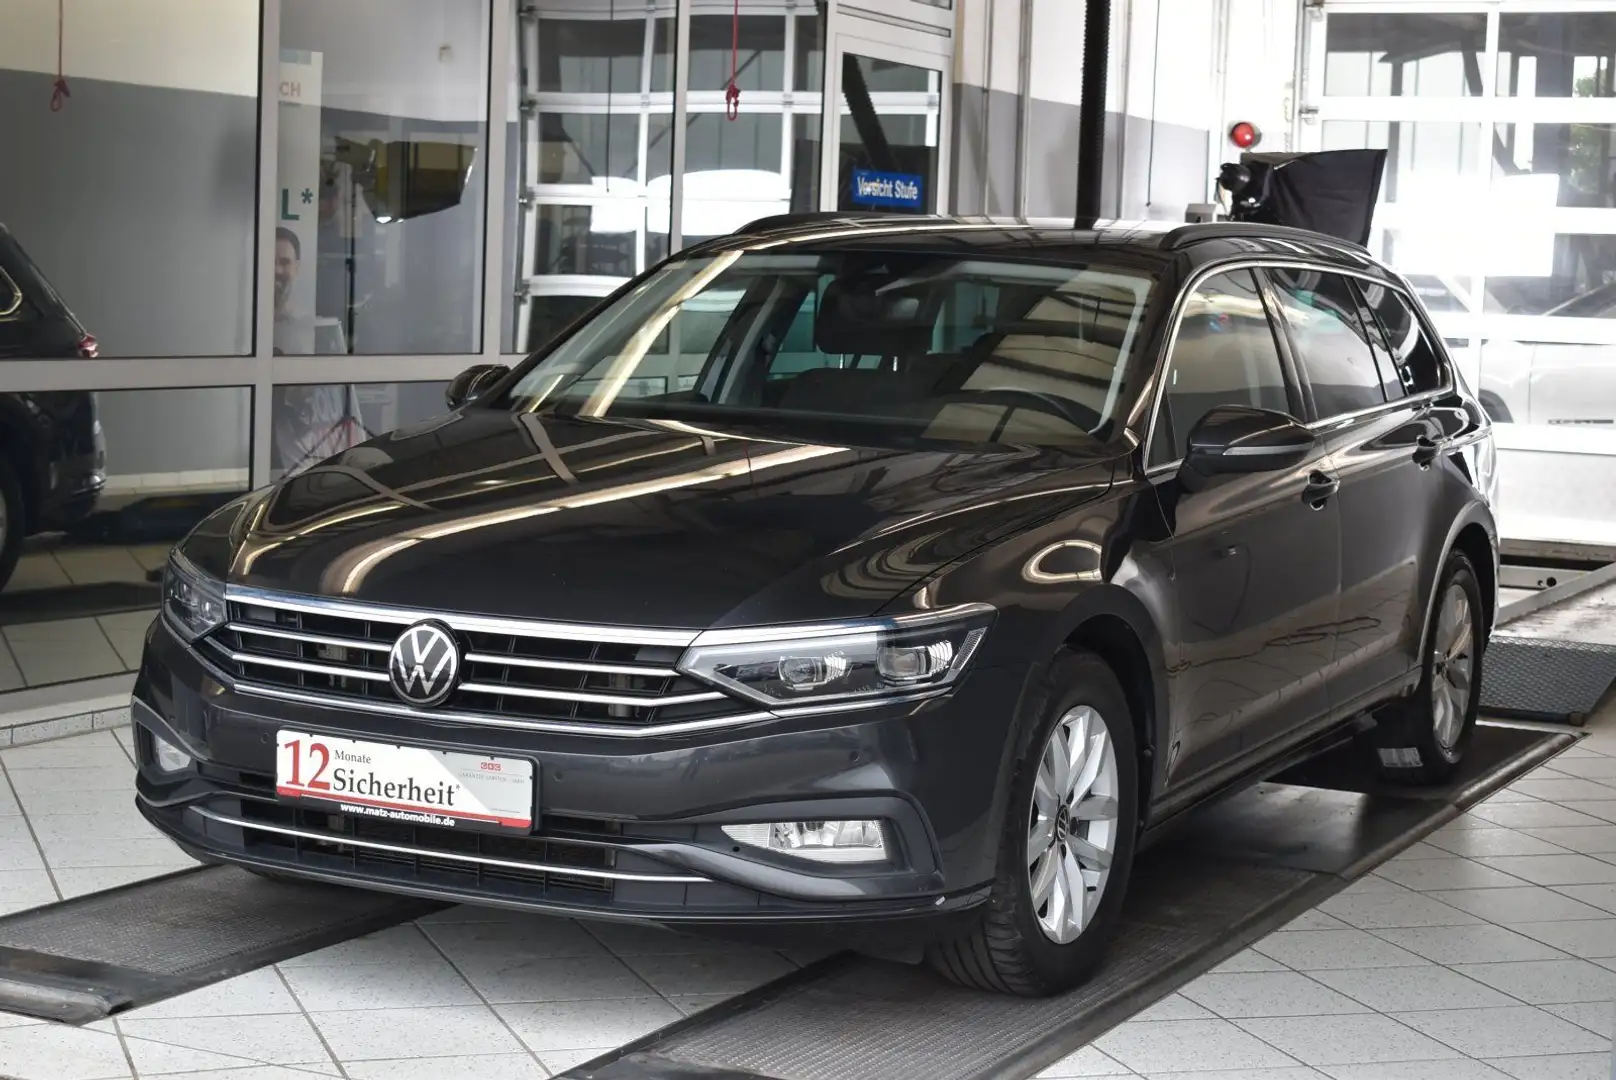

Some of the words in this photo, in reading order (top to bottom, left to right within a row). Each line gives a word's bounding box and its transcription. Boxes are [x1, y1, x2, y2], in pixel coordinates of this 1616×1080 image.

[894, 180, 918, 200] Stufe
[284, 739, 330, 790] 12
[334, 749, 371, 764] Monate
[340, 803, 455, 826] www.matz-automobile.de
